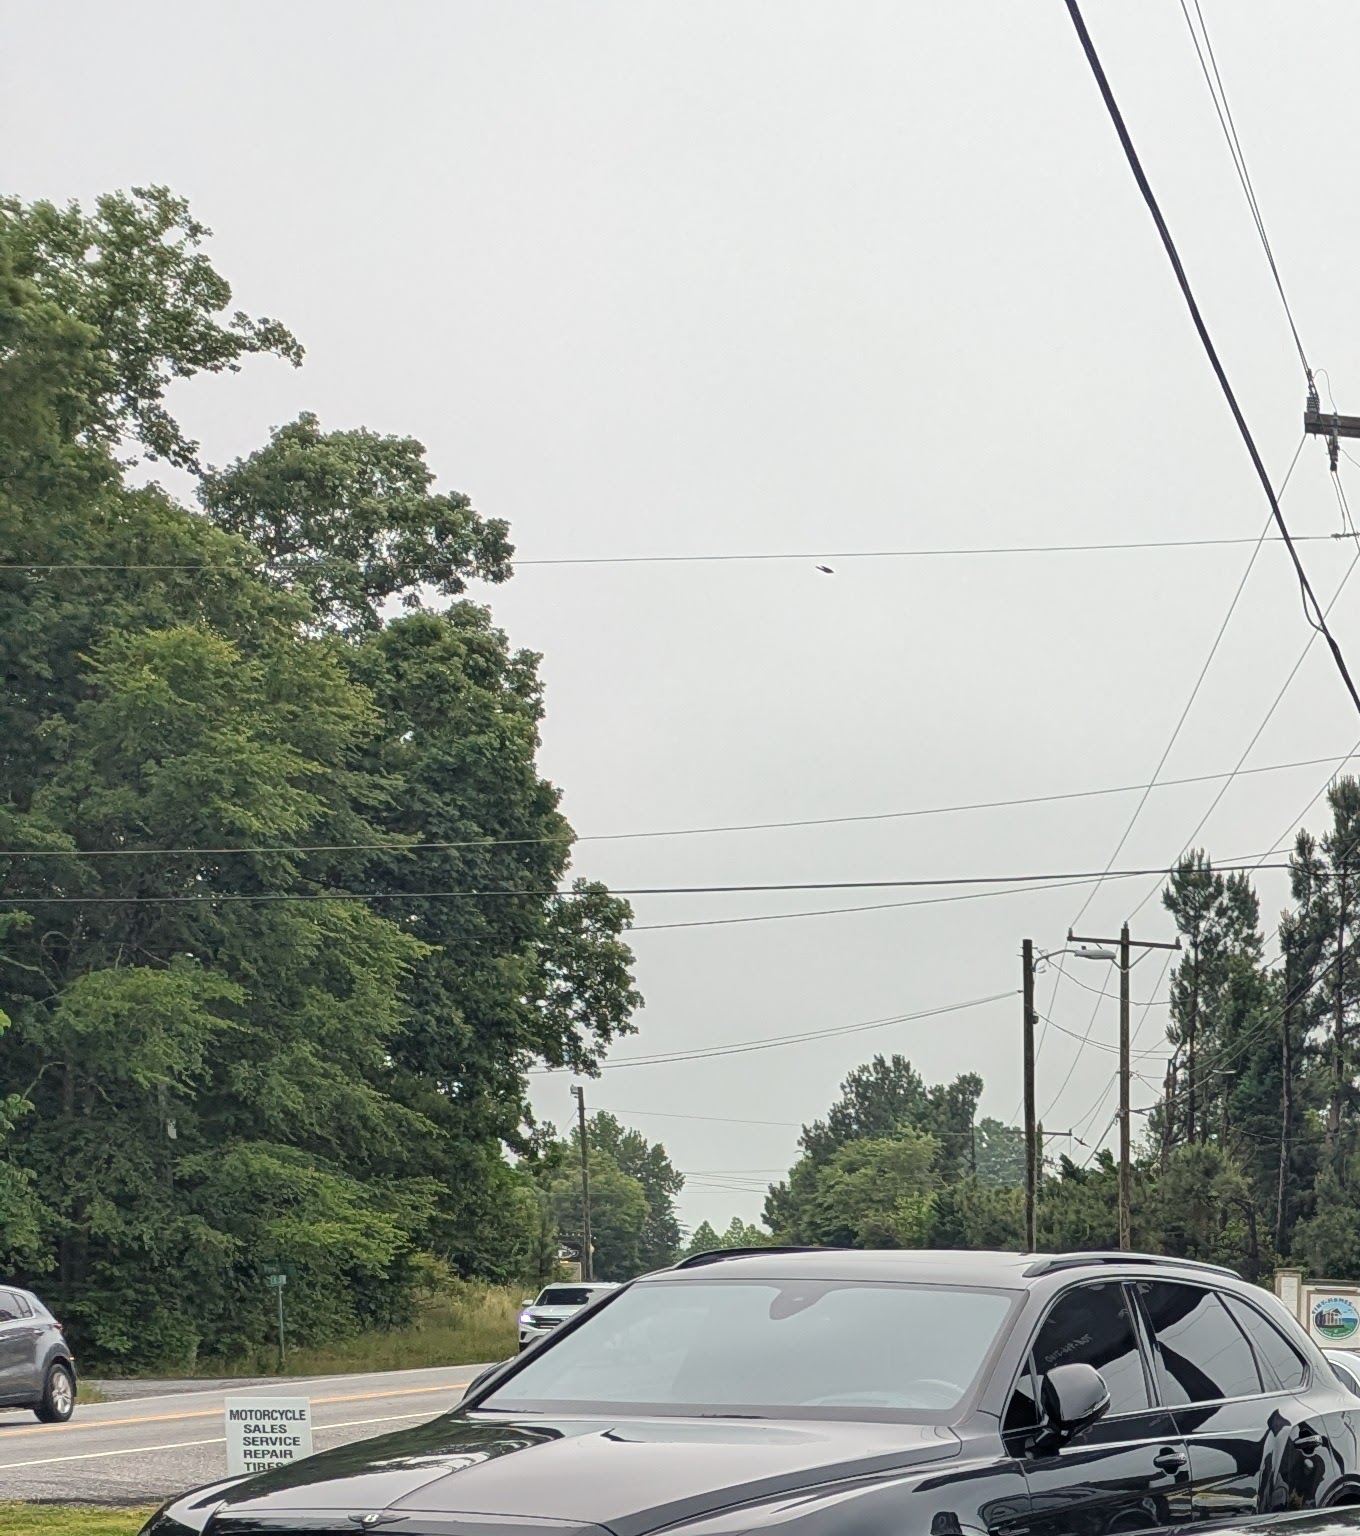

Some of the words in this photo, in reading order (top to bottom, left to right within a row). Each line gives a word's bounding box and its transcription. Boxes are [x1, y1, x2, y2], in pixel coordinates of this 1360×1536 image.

[229, 1409, 306, 1421] MOTORCYCLE
[243, 1424, 288, 1434] SALES
[243, 1436, 301, 1446] SERVICE
[243, 1449, 293, 1459] REPAIR
